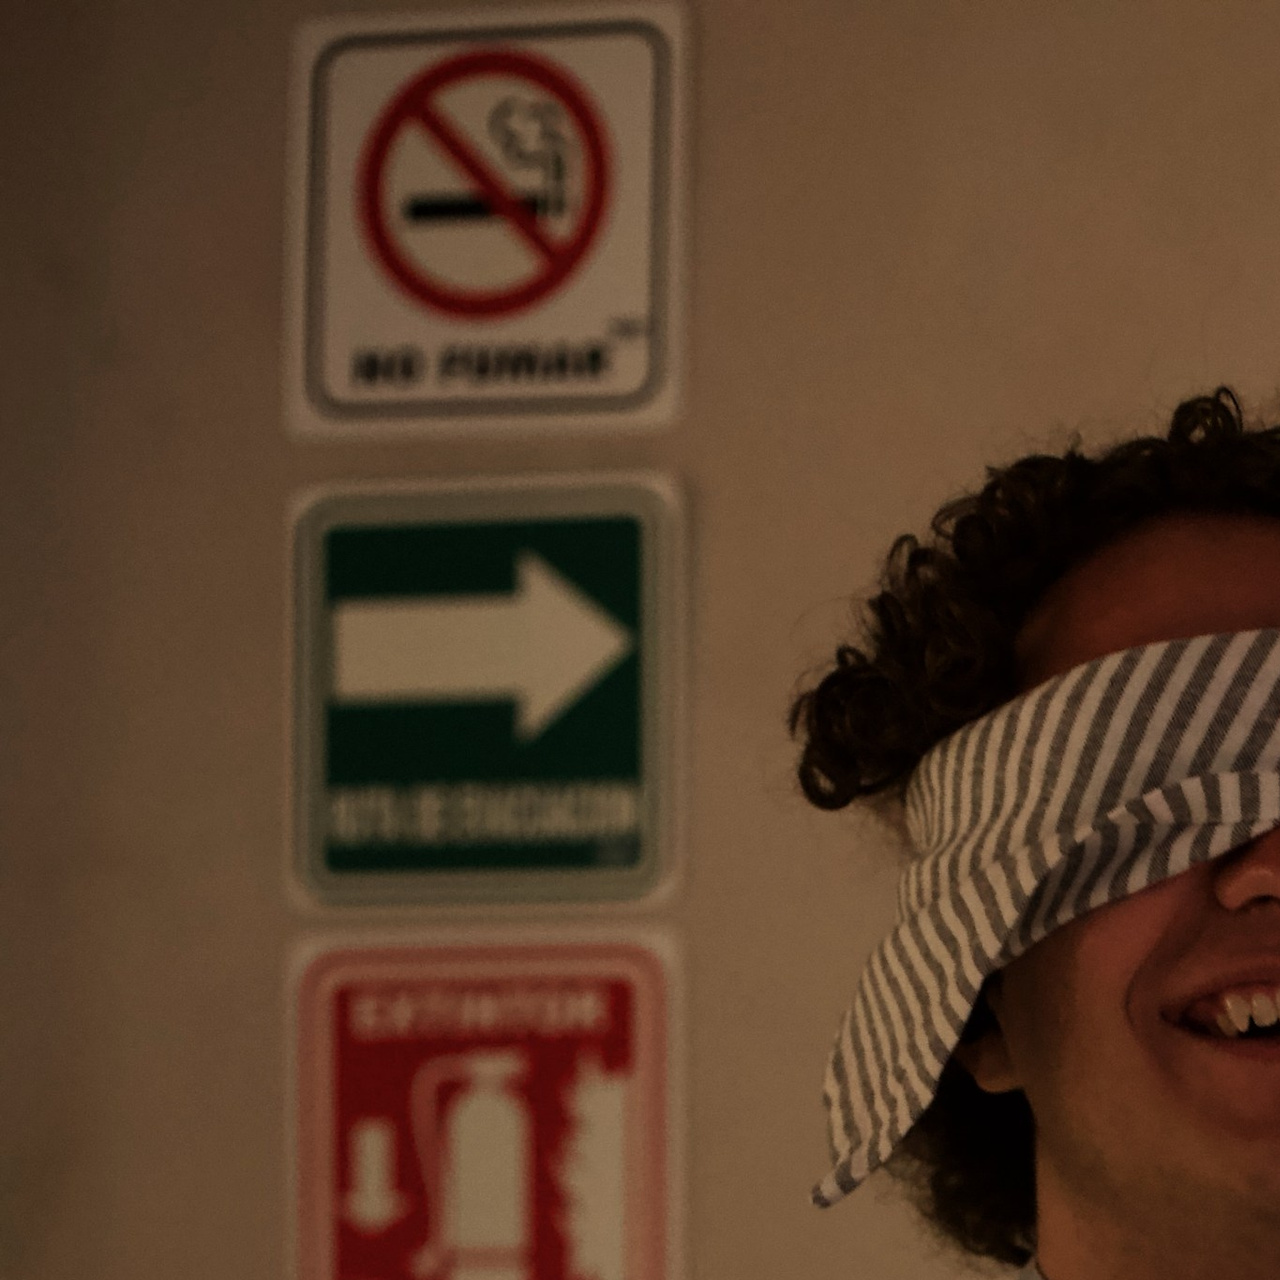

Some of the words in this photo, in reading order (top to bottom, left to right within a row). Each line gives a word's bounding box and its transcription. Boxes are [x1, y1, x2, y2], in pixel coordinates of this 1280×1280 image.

[351, 347, 424, 386] NO
[437, 341, 611, 384] FUMAR
[349, 990, 610, 1040] EXTINTOR
